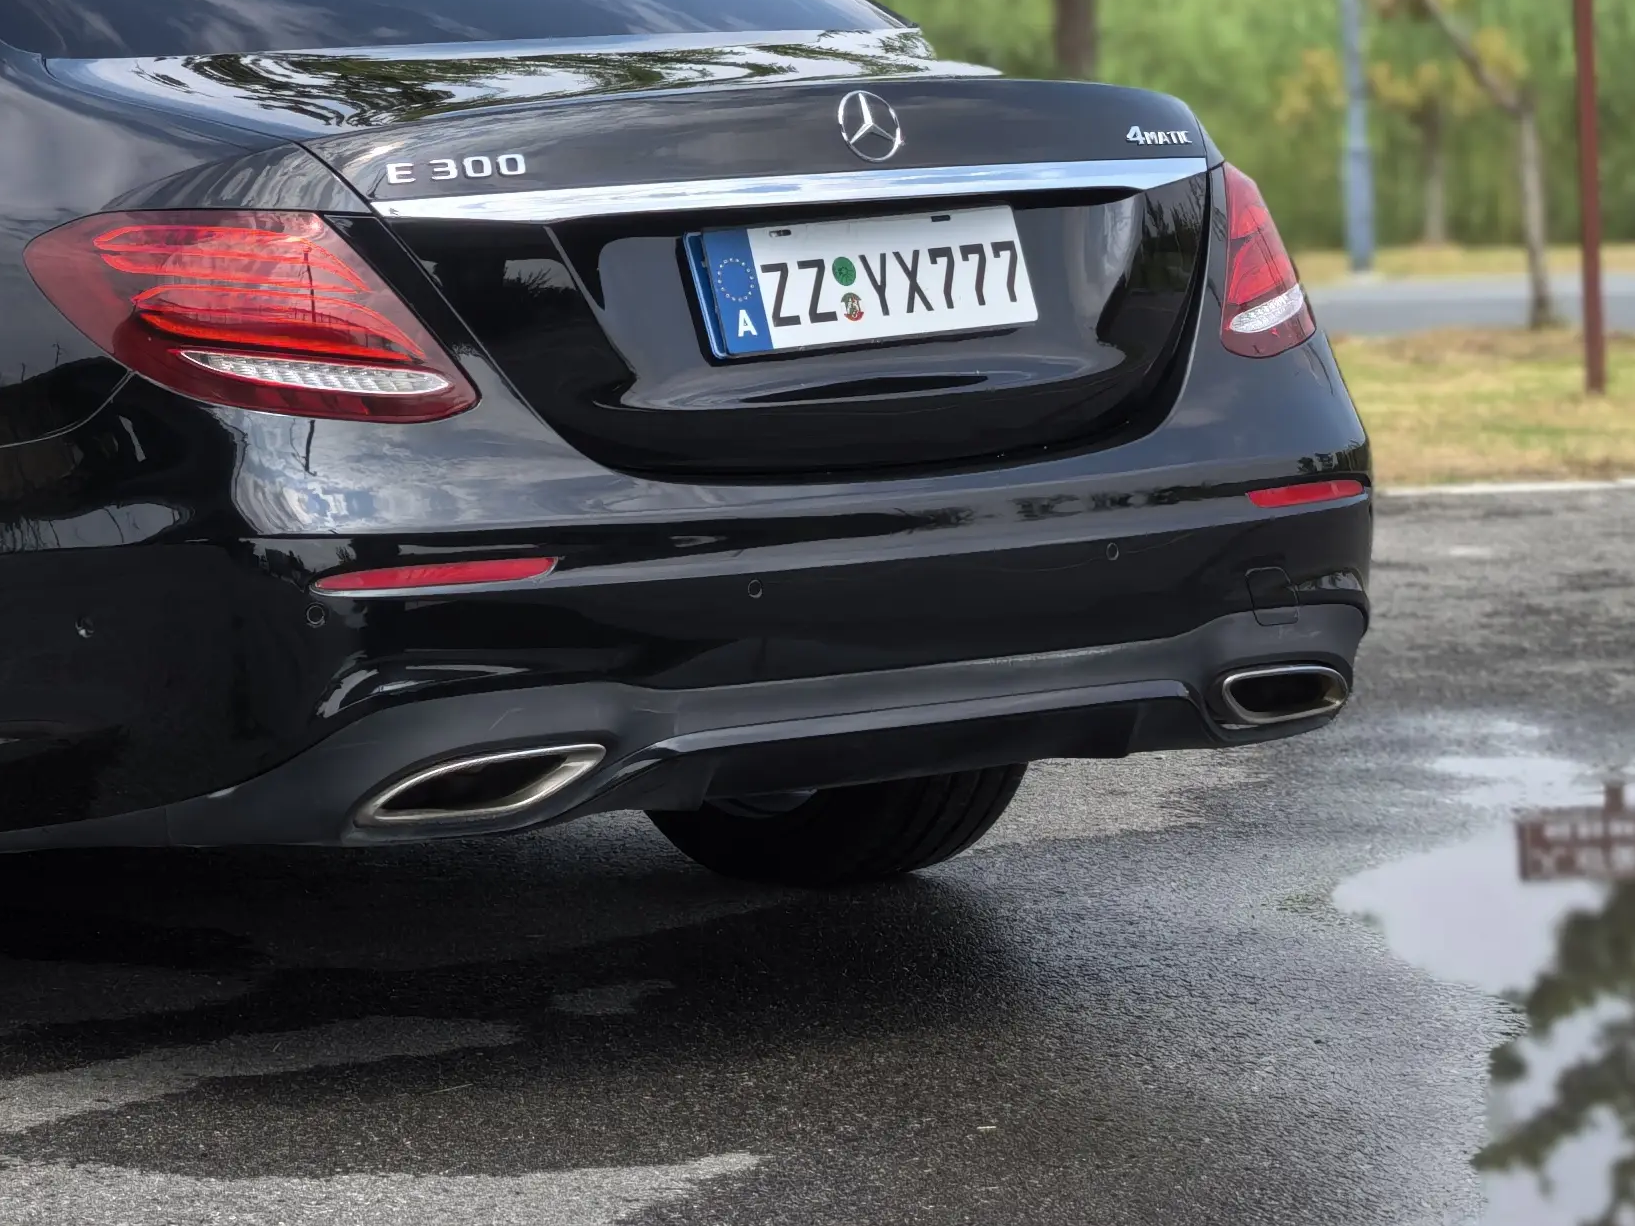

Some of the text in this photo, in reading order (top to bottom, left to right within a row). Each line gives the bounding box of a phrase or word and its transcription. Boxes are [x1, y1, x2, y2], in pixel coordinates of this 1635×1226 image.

[386, 154, 526, 184] E 300
[760, 240, 1018, 327] ZZ YX777
[737, 309, 758, 337] A
